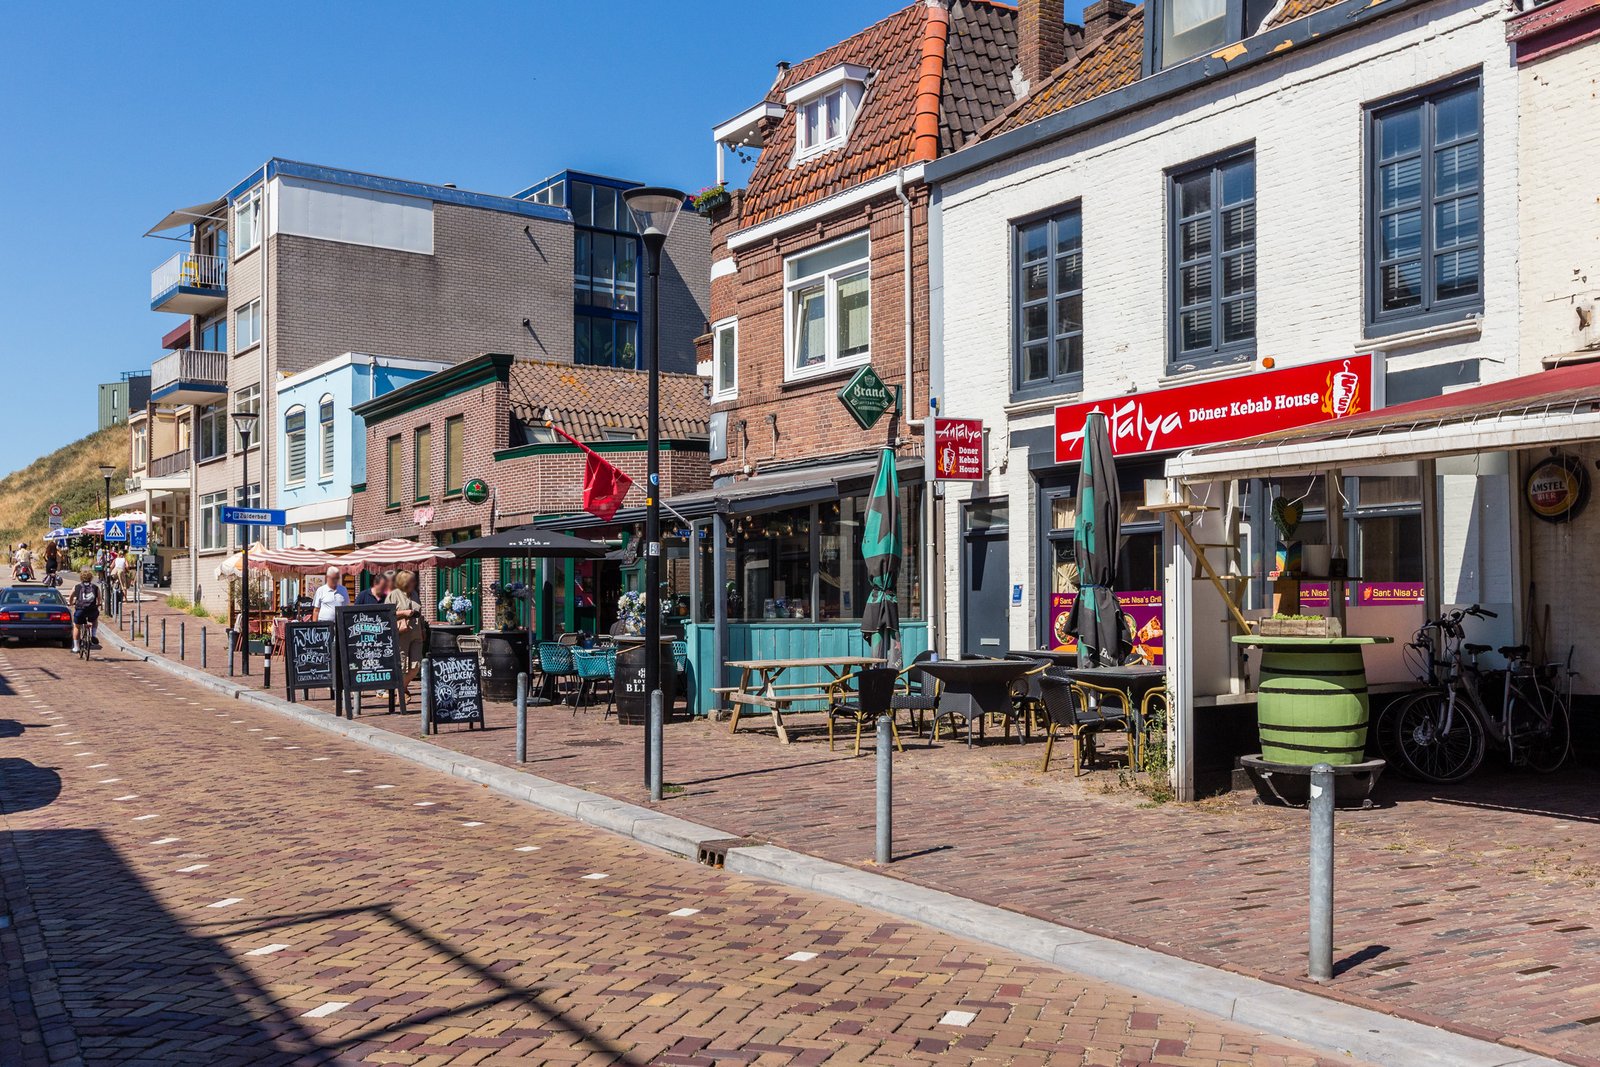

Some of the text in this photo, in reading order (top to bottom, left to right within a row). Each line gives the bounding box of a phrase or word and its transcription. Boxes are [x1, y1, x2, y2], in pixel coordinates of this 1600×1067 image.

[854, 384, 885, 397] Brand
[1060, 392, 1319, 452] Atalya Döner Kebab House
[936, 422, 981, 443] Antalya
[959, 456, 979, 464] Kebab
[1531, 481, 1565, 493] AMSTEL
[1537, 493, 1556, 501] BIER
[134, 525, 143, 537] P
[1393, 588, 1417, 596] Nisa's
[301, 654, 324, 663] OPEN
[433, 659, 474, 676] JAPANSE
[356, 673, 391, 683] GEZELLIG
[443, 671, 473, 682] CHICKEN
[626, 684, 645, 692] BLI
